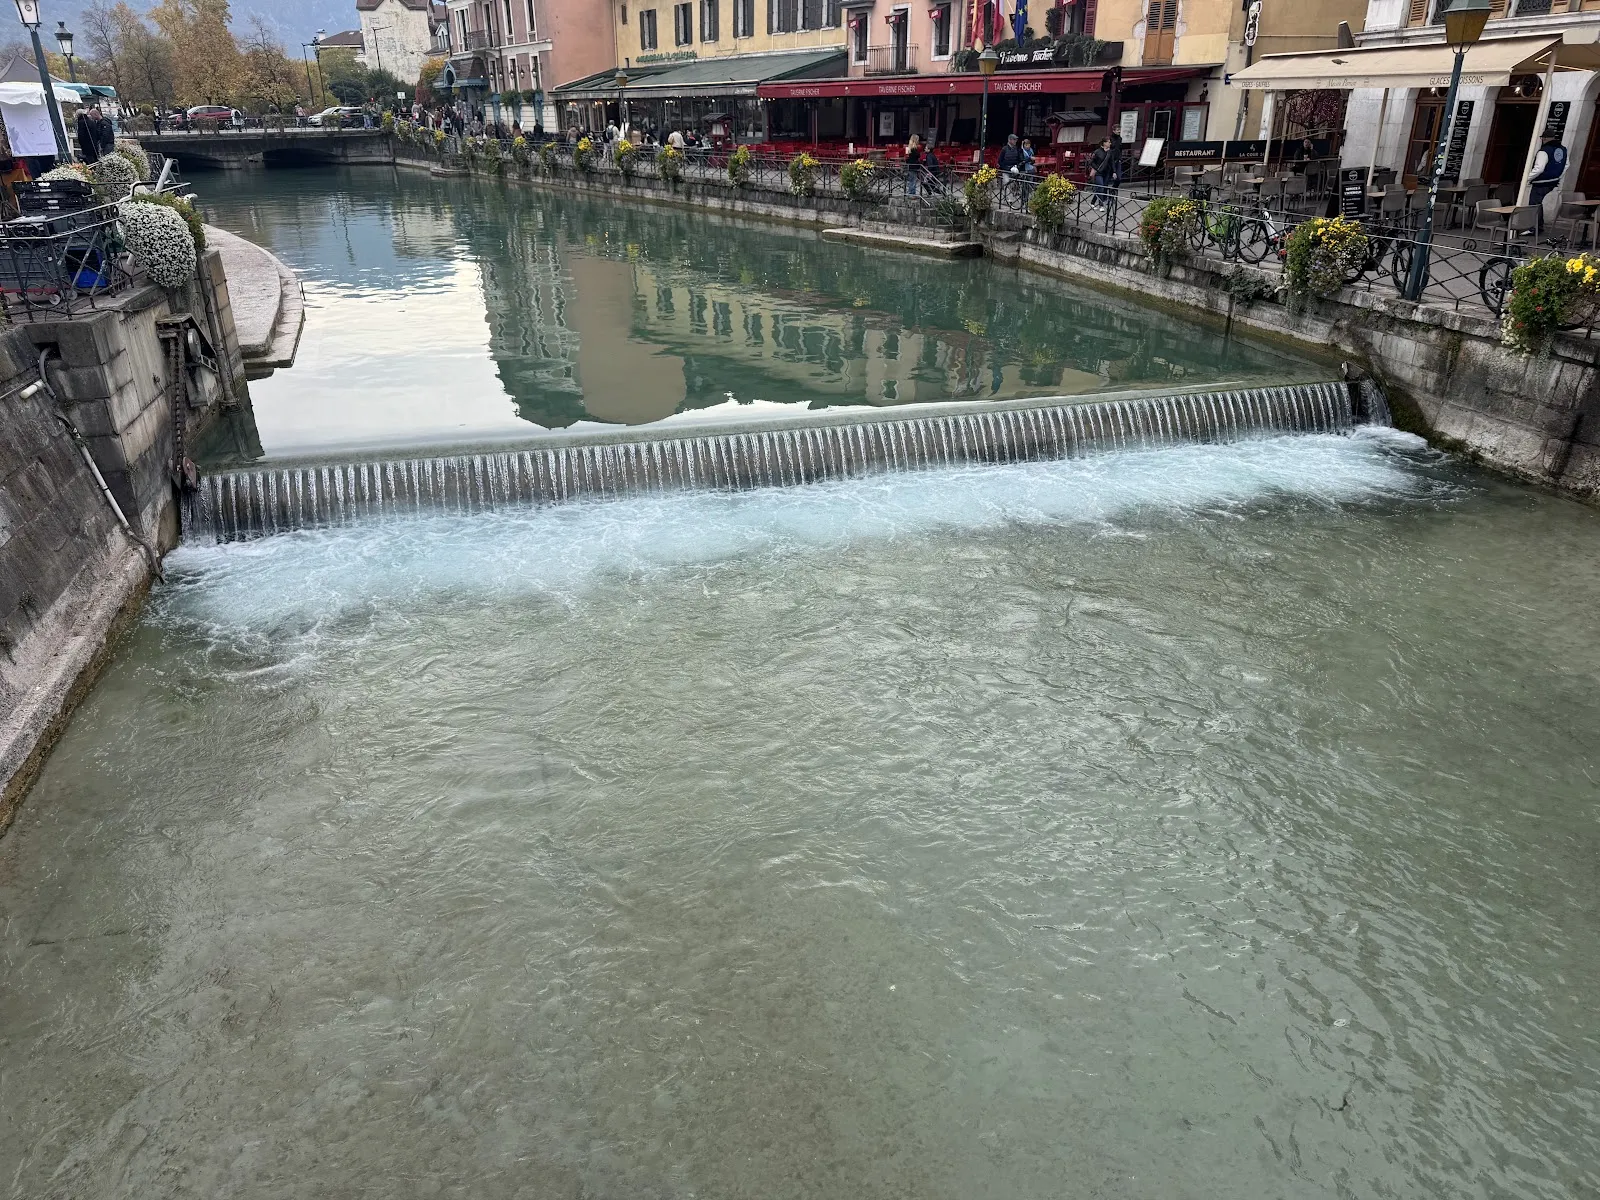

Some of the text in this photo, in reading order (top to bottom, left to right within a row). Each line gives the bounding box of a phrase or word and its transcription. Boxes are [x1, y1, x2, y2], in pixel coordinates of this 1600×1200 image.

[1430, 75, 1485, 85] GLACES OISSONS
[878, 85, 916, 94] TAVERNE FISCHER
[994, 82, 1042, 91] TAVERNE FISCHER
[1174, 149, 1216, 157] RESTAURANT
